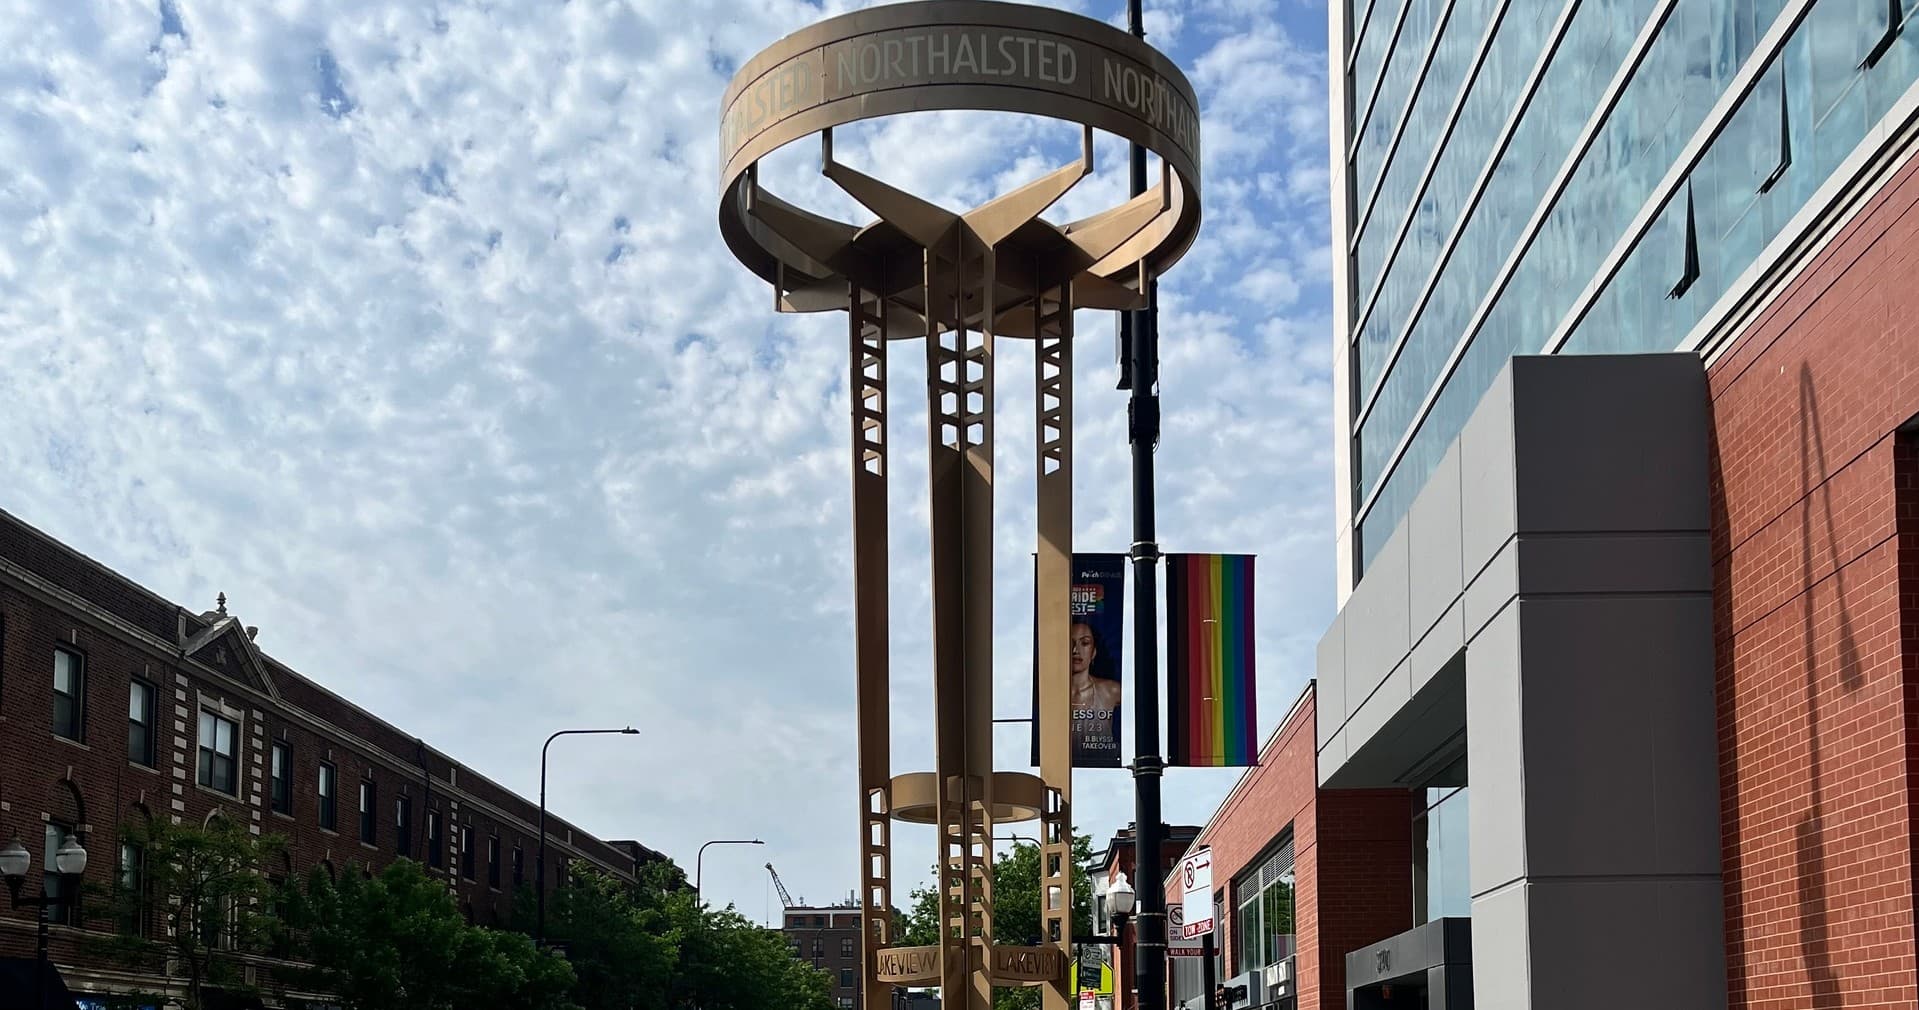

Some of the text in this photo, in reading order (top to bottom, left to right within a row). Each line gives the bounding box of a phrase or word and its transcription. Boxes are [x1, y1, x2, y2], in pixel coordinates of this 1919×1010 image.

[837, 34, 1078, 92] NORTHALSTED
[1072, 591, 1096, 603] RIDE
[1097, 710, 1113, 720] OF
[1089, 723, 1102, 732] 23
[1170, 948, 1201, 956] WALK YOUR
